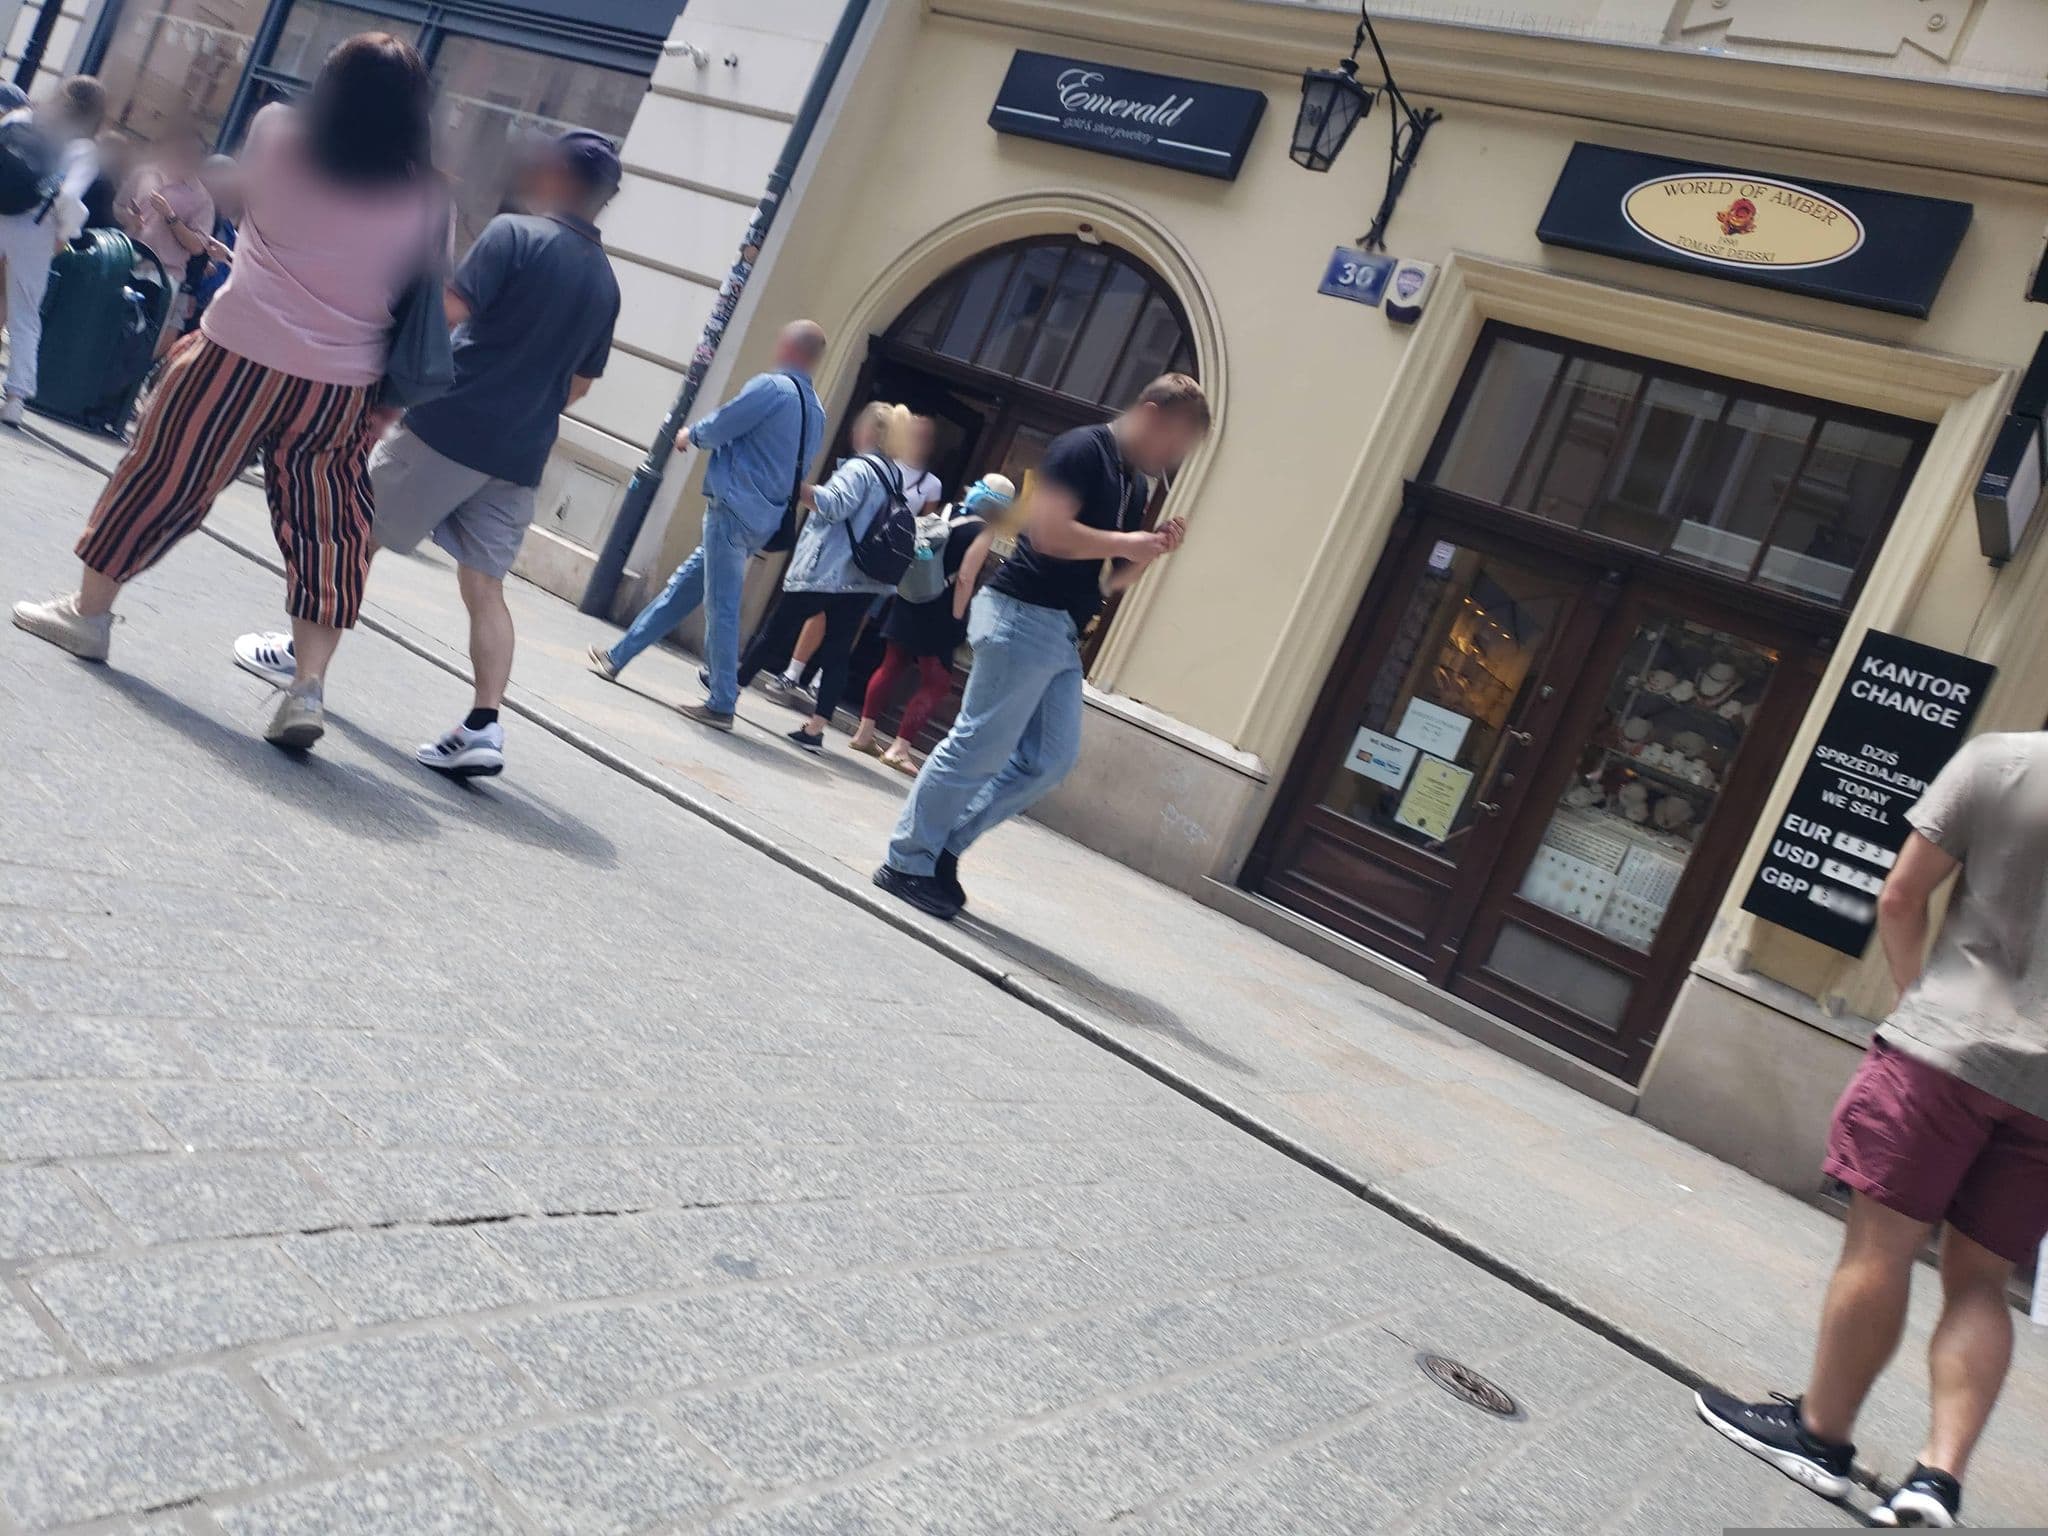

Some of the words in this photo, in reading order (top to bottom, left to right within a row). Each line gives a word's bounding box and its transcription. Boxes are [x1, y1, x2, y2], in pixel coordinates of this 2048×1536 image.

[1057, 69, 1194, 127] Emerald
[1663, 181, 1733, 197] WORLD
[1740, 184, 1768, 199] OF
[1770, 190, 1839, 227] AMBER
[1677, 236, 1725, 255] TOMASZ
[1338, 261, 1376, 289] 30
[1860, 656, 1971, 705] KANTOR
[1850, 679, 1962, 729] CHANGE
[1821, 789, 1848, 809] WE
[1849, 800, 1891, 825] SELL
[1836, 777, 1892, 806] TODAY
[1783, 812, 1833, 845] EUR
[1772, 838, 1820, 870] USD
[1760, 865, 1810, 896] GBP
